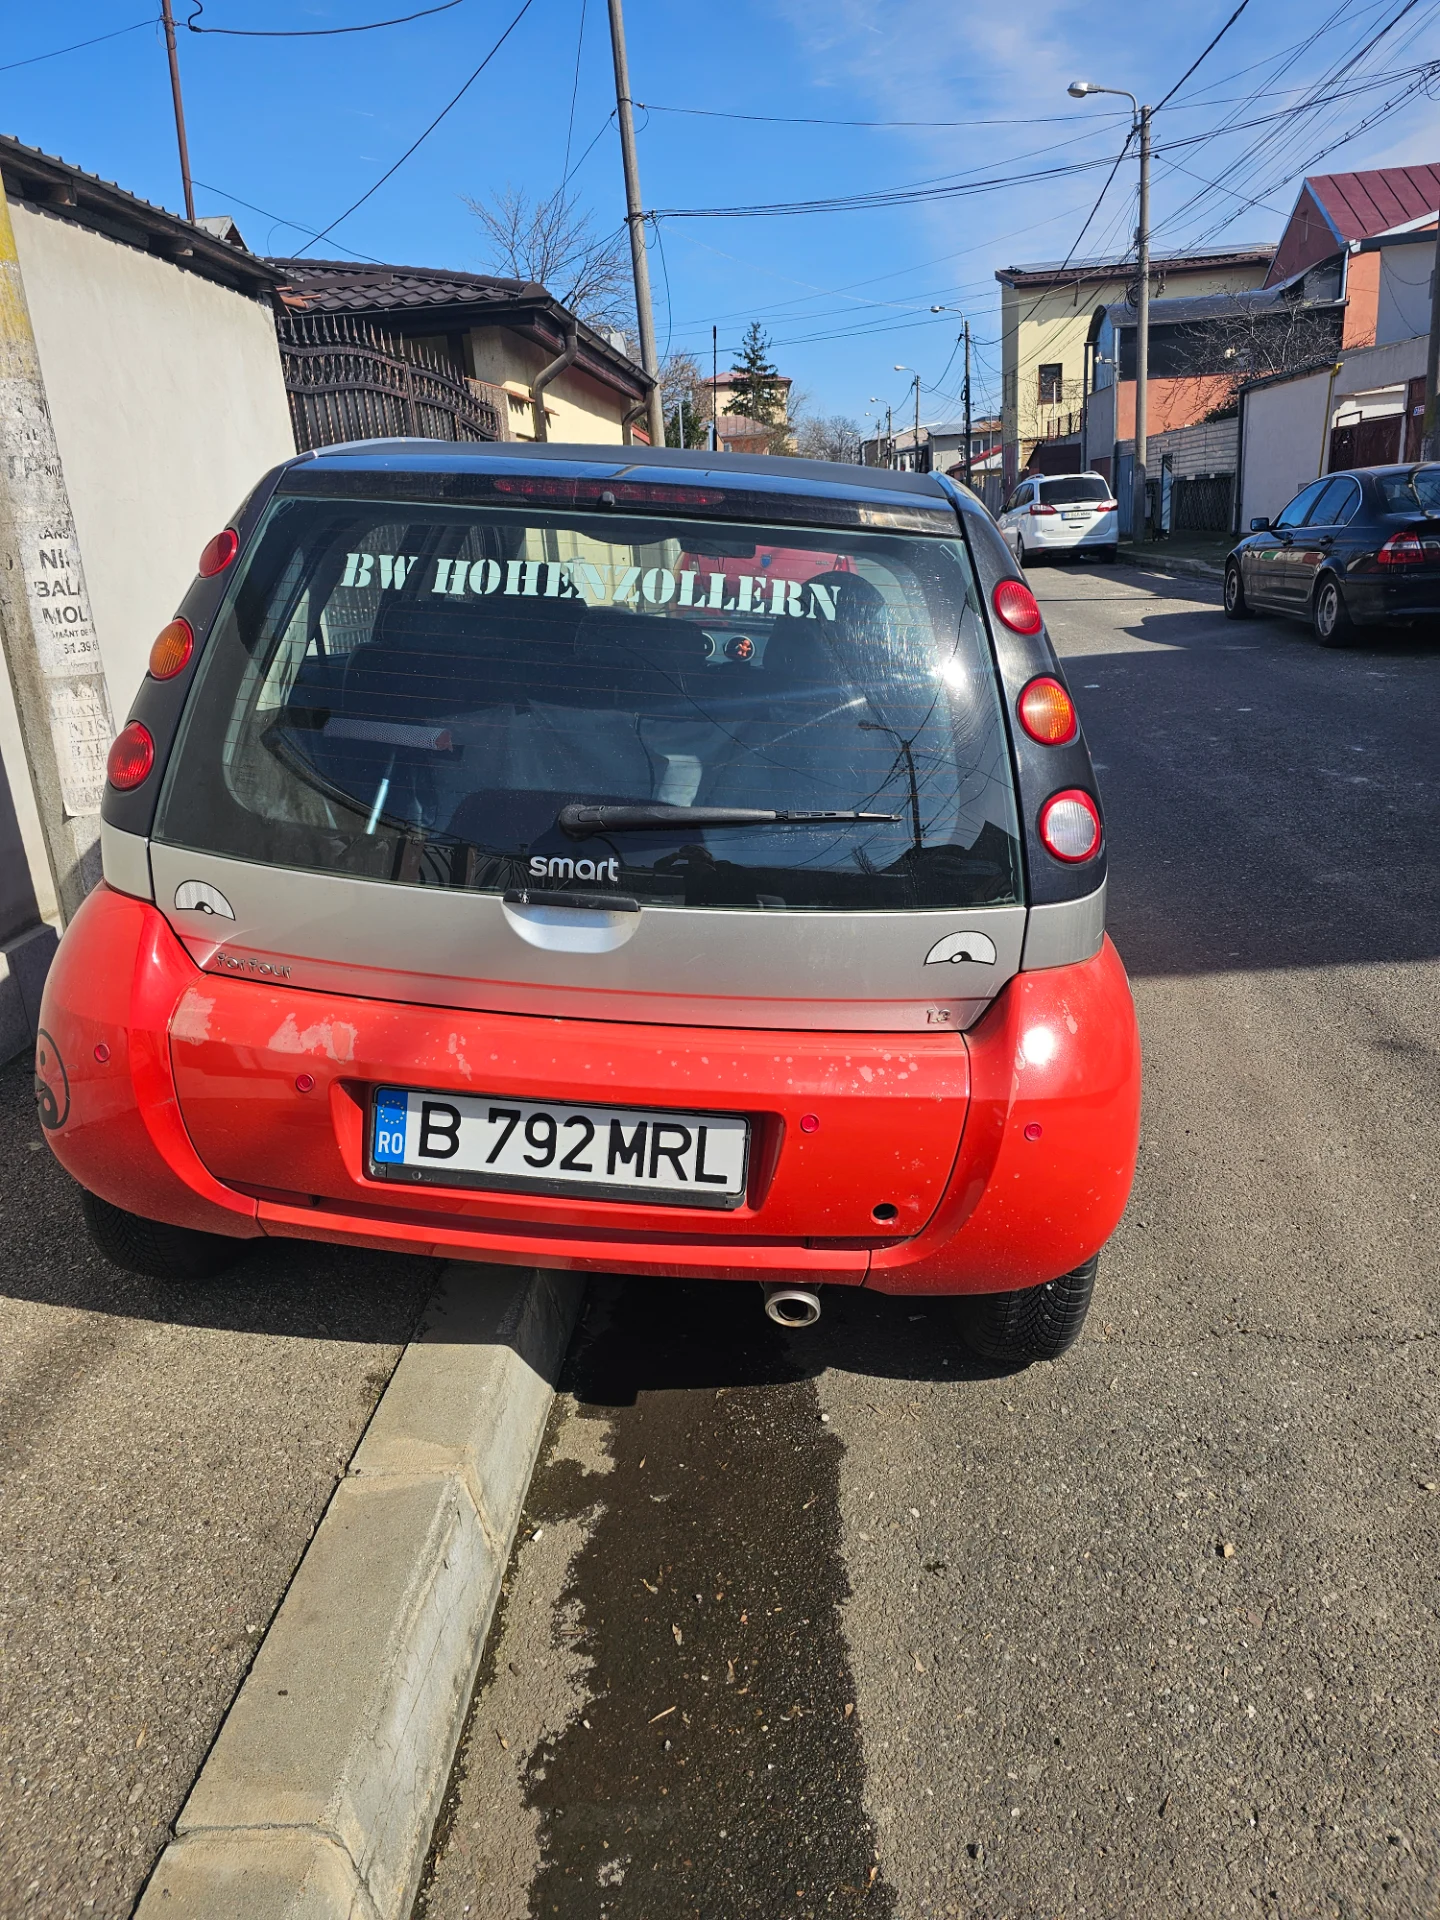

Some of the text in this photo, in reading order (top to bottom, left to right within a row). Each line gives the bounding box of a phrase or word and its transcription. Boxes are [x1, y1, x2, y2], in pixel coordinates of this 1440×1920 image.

[341, 553, 843, 621] BW HOHENZOLLERN
[529, 856, 619, 882] smart
[377, 1130, 403, 1155] RO
[418, 1100, 728, 1185] B 792 MRL
